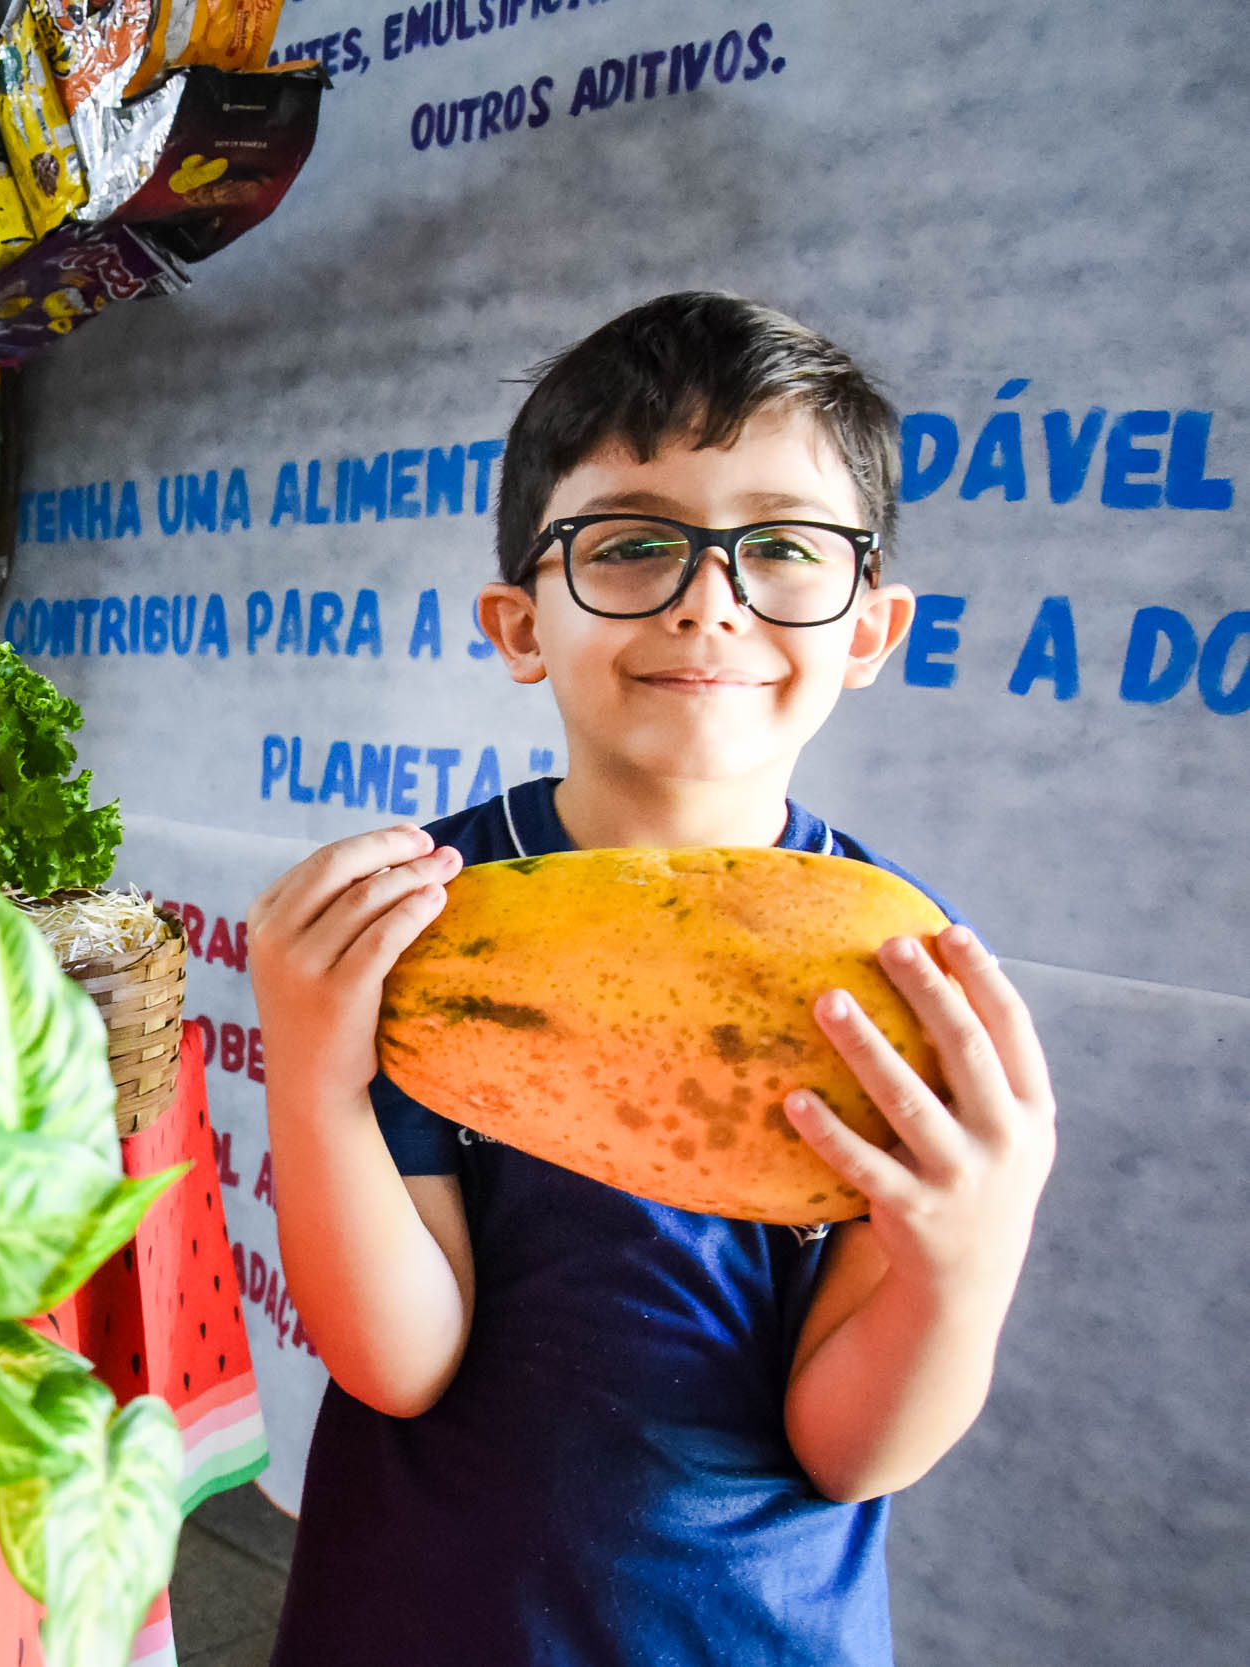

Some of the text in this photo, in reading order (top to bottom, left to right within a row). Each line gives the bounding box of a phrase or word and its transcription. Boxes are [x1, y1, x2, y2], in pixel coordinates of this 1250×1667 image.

[410, 22, 786, 151] OUTROS ADITIVOS.
[20, 480, 142, 543] TENHA
[270, 439, 505, 527] ALIMENT
[898, 378, 1234, 511] DÁVEL
[5, 592, 229, 660] CONTRIBUA
[248, 588, 382, 659] PARA
[408, 588, 442, 660] A
[1008, 595, 1081, 702] A
[1119, 606, 1250, 717] DO
